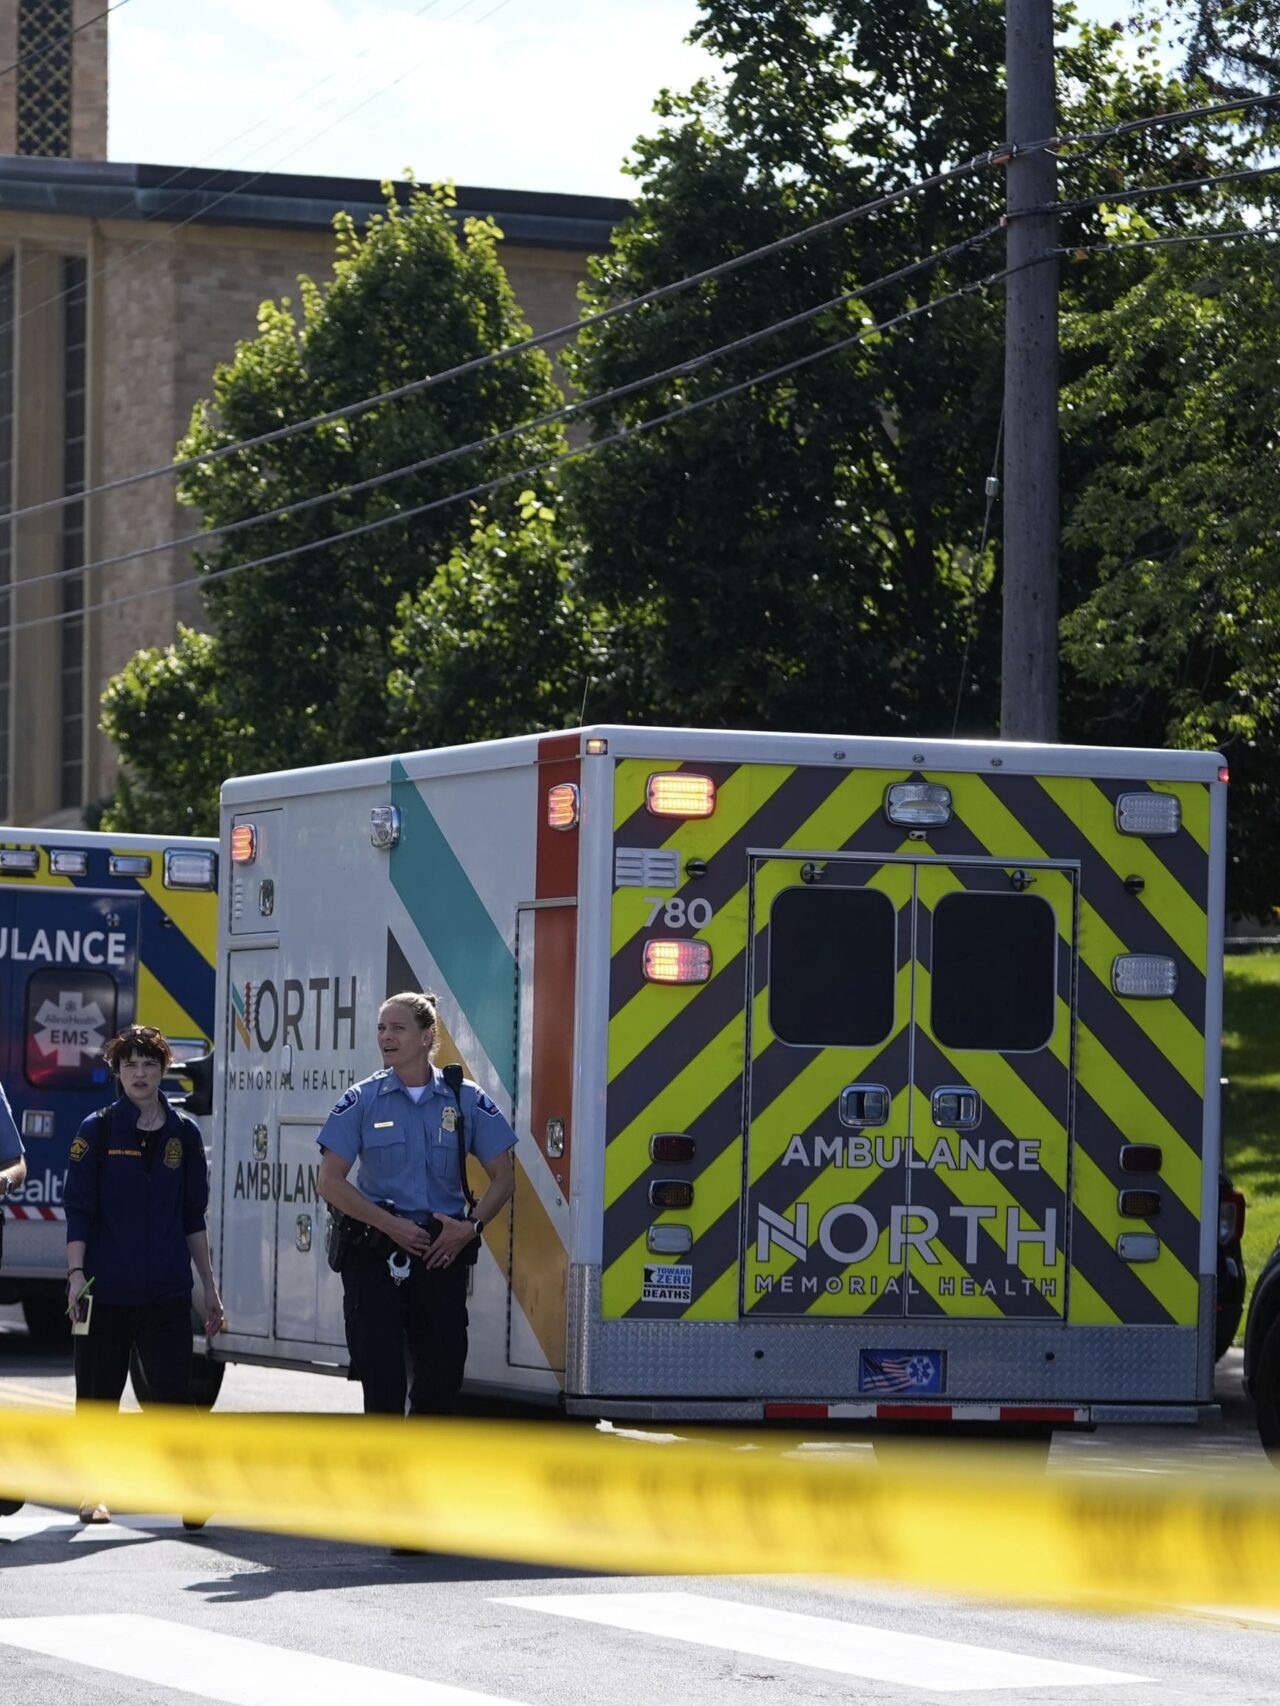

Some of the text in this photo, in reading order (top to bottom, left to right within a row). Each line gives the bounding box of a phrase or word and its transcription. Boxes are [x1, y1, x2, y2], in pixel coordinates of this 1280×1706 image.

[642, 897, 713, 929] 780
[231, 976, 357, 1053] NORTH
[50, 1029, 89, 1046] EMS
[229, 1069, 355, 1090] MEMORIAL HEALTH
[781, 1135, 1042, 1172] AMBULANCE
[5, 1168, 68, 1203] ealt
[233, 1161, 321, 1204] AMBULAN
[757, 1202, 1057, 1266] NORTH
[656, 1274, 690, 1285] ZERO
[657, 1267, 691, 1275] TOWARD
[643, 1289, 690, 1300] DEATHS
[754, 1274, 1057, 1297] MEMORIAL HEALTH
